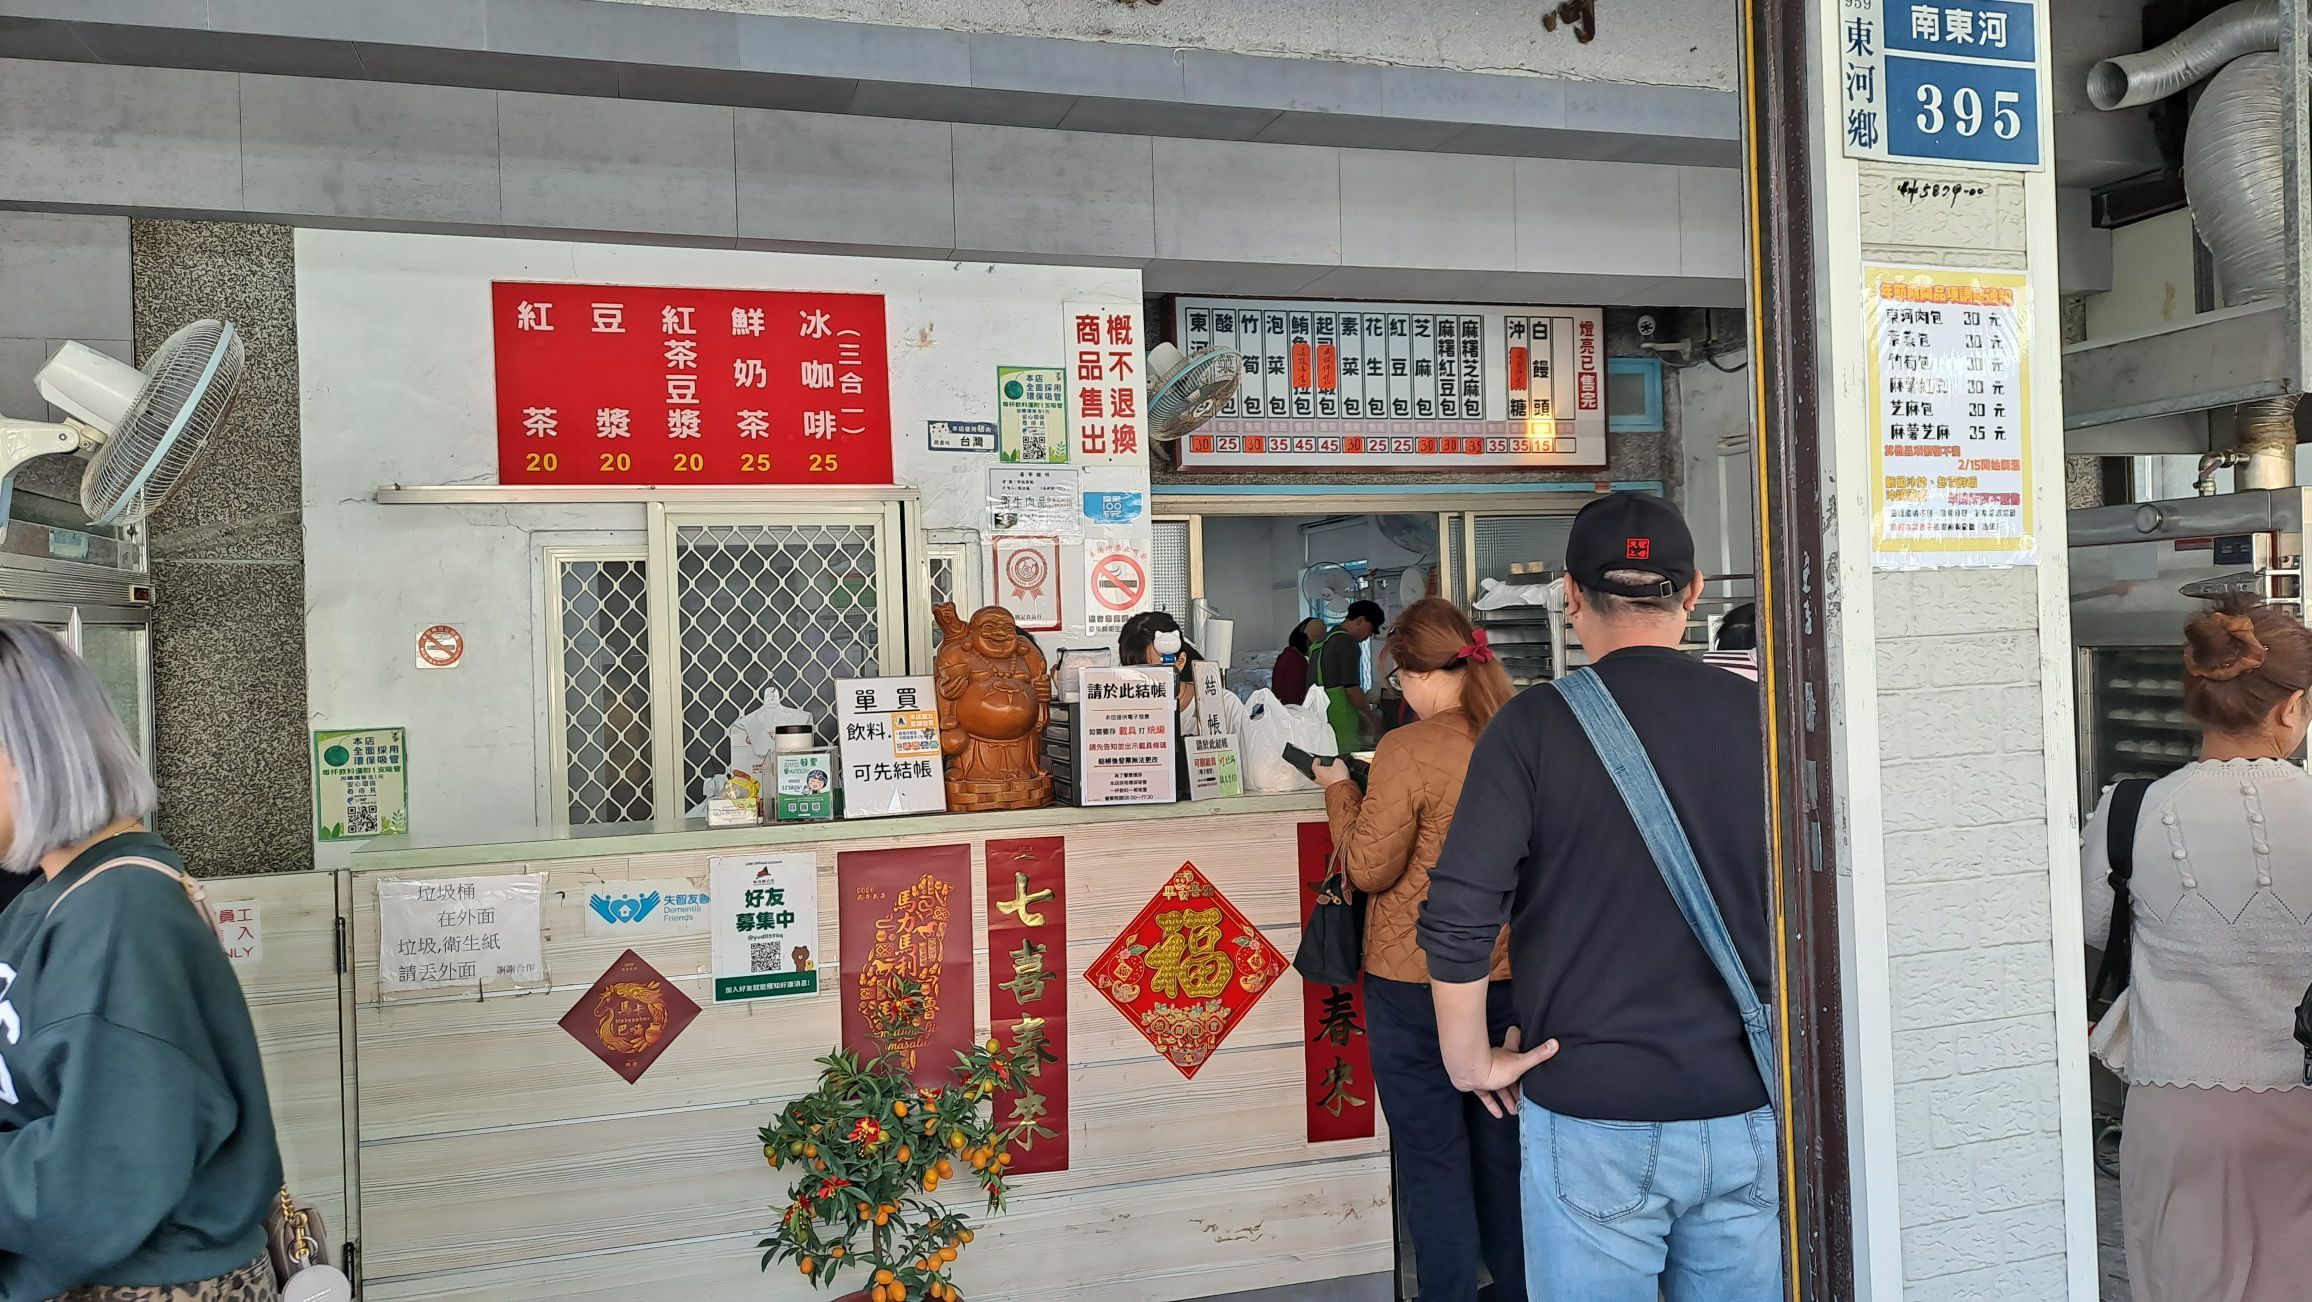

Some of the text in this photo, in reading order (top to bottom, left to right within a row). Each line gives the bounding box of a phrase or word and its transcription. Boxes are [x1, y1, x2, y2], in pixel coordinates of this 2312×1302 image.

[1911, 4, 2008, 48] 南東河
[1844, 17, 1879, 149] 東河鄉
[1916, 84, 2021, 140] 395
[1964, 312, 1980, 325] 30
[1989, 312, 2002, 326] 元
[1966, 335, 1982, 348] 30
[1991, 335, 2004, 349] 元
[517, 301, 558, 438] 紅茶
[591, 302, 631, 439] 豆漿
[661, 305, 702, 440] 紅茶豆漿
[730, 306, 771, 440] 鮮奶茶
[799, 309, 837, 441] 冰咖啡
[1241, 314, 1261, 414] 竹筍包
[1266, 315, 1286, 414] 泡菜包
[1341, 317, 1361, 415] 素菜包
[1365, 317, 1385, 415] 花生包
[1389, 318, 1409, 416] 紅豆包
[1414, 318, 1432, 416] 芝麻包
[1532, 321, 1551, 416] 白饅頭
[1967, 357, 1983, 371] 30
[1992, 357, 2005, 372] 元
[836, 328, 866, 435] (三合一)
[1026, 374, 1043, 382] 本店
[1075, 314, 1106, 454] 商品售出
[1106, 314, 1137, 455] 概不退換
[1967, 380, 1984, 394] 30
[1992, 381, 2005, 395] 元
[1891, 400, 2006, 417] 芝麻包 30 元
[960, 436, 984, 447] 台灣
[1969, 426, 1985, 440] 35
[1994, 426, 2007, 440] 元
[1195, 438, 1209, 450] 30
[1218, 438, 1237, 450] 25
[1247, 438, 1262, 450] 30
[1270, 438, 1289, 450] 35
[1295, 438, 1314, 450] 45
[1321, 440, 1339, 451] 45
[1348, 438, 1361, 451] 30
[1369, 439, 1387, 451] 25
[1394, 440, 1411, 451] 25
[1420, 440, 1434, 451] 30
[1443, 439, 1457, 451] 30
[1488, 440, 1506, 452] 35
[1512, 440, 1530, 452] 35
[1533, 440, 1550, 452] 15
[526, 452, 838, 472] 20 20 20 25 25
[855, 688, 918, 711] 單買
[1088, 683, 1167, 700] 請於此結帳
[1205, 675, 1221, 736] 結帳
[353, 737, 375, 746] 本店
[353, 745, 399, 756] 全面採用
[354, 755, 399, 765] 環保吸管
[853, 760, 933, 782] 可先結帳
[417, 883, 475, 902] 垃圾桶
[745, 887, 785, 908] 好友
[214, 908, 253, 924] 員工
[438, 907, 495, 928] 在外面
[664, 914, 694, 922] Friends
[736, 910, 795, 932] 募集中
[894, 889, 918, 977] 馬力馬利
[1144, 907, 1233, 998] 福
[496, 963, 535, 975] 謝謝合作
